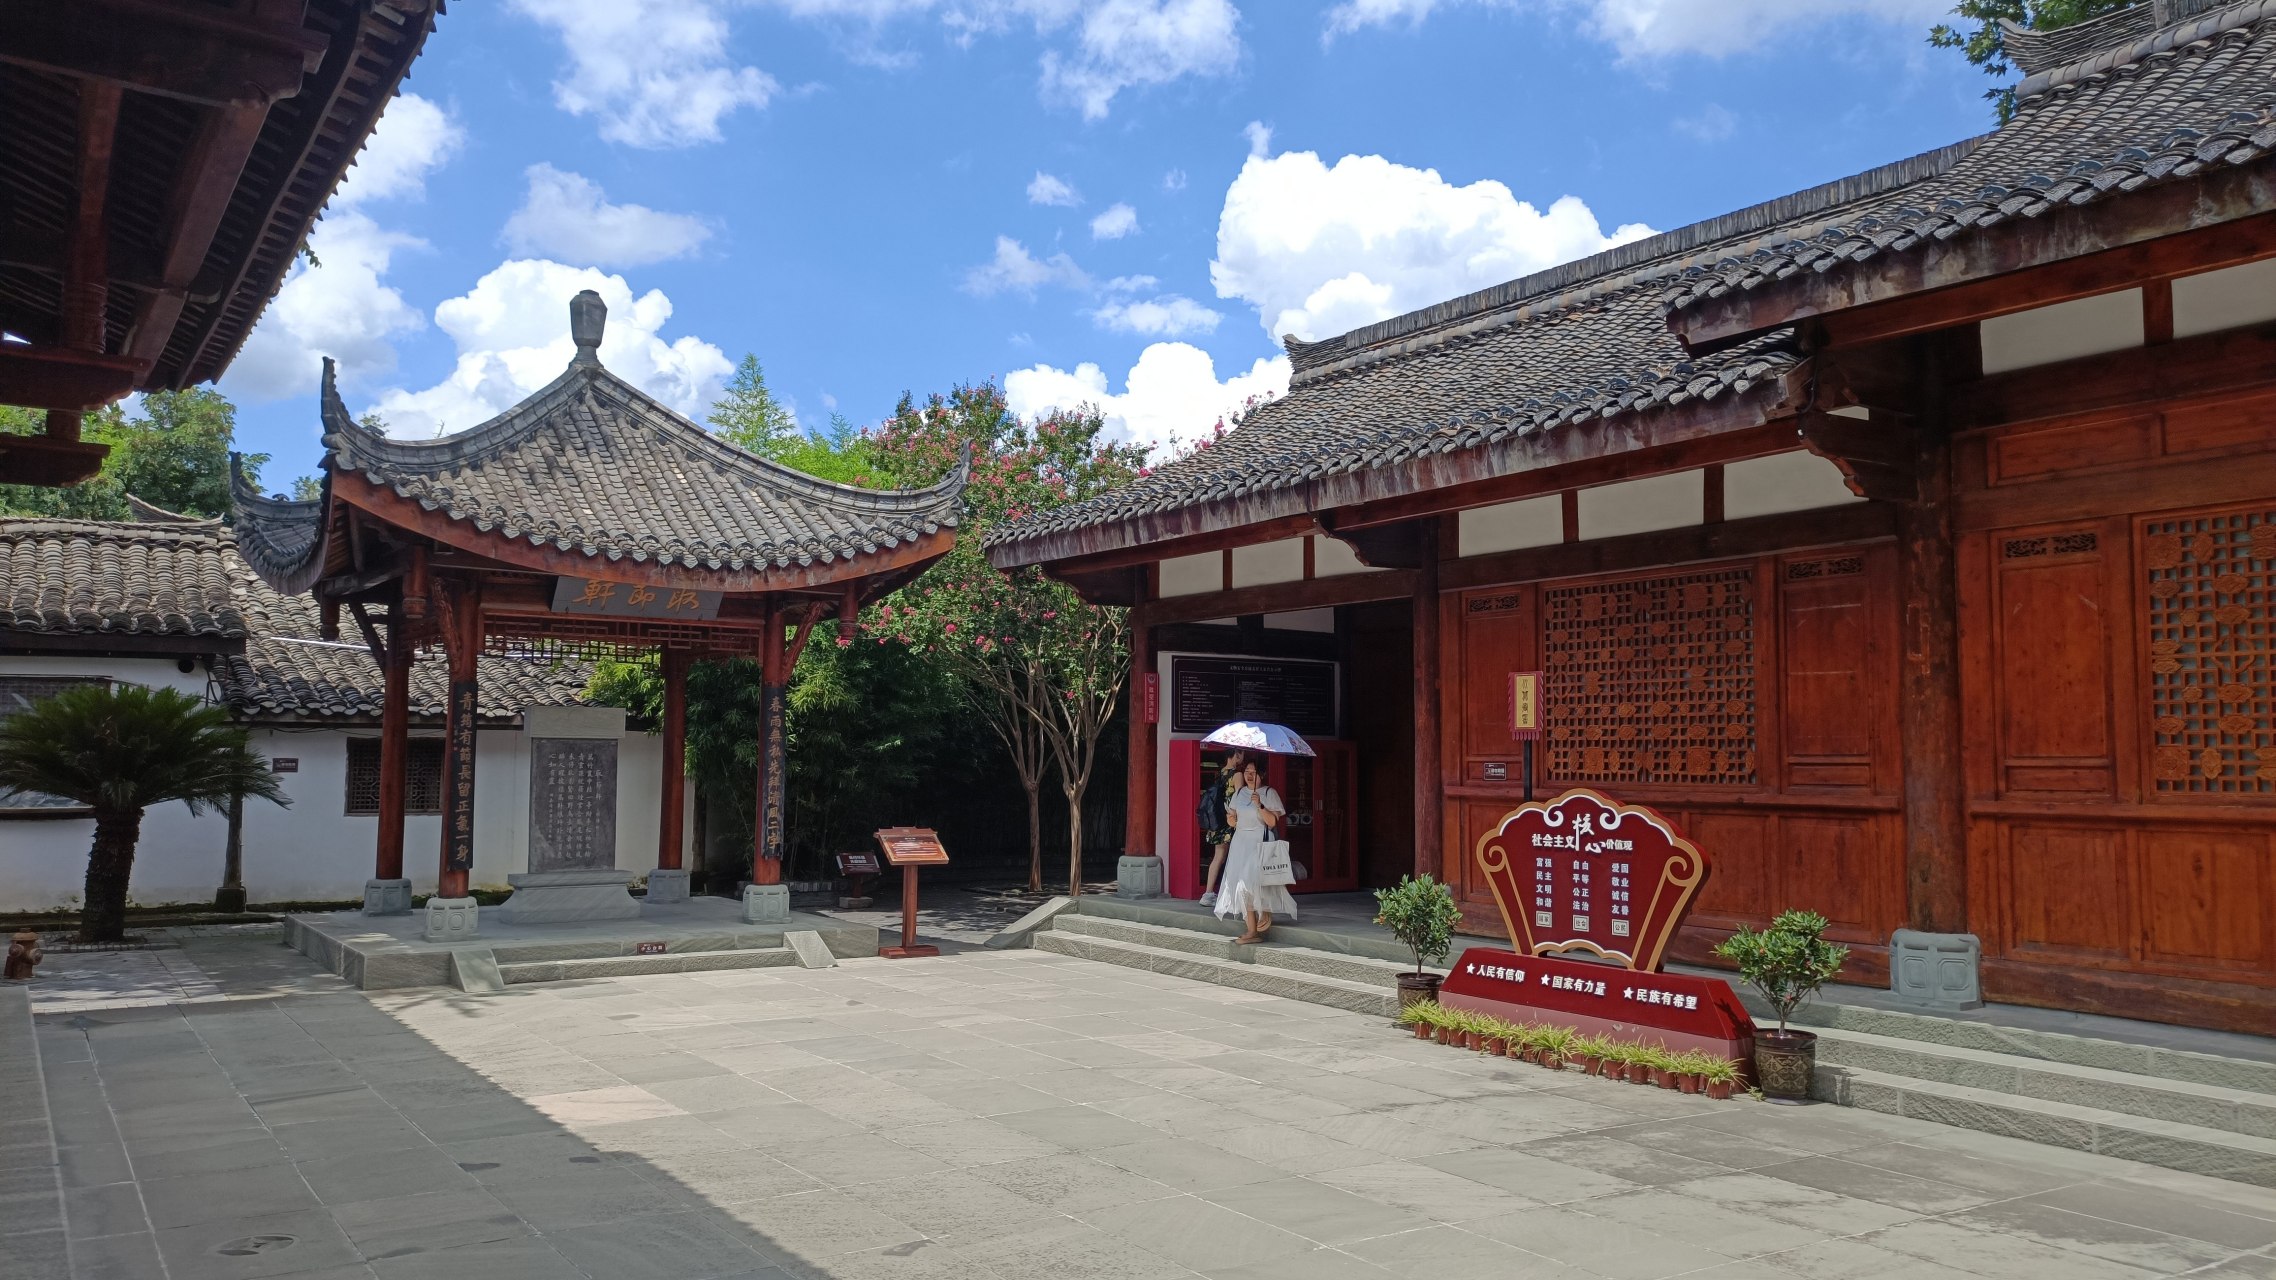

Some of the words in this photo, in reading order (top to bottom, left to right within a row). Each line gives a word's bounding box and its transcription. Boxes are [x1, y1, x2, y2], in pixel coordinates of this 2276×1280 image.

[1532, 833, 1575, 849] 社会主义
[1535, 857, 1553, 869] 富强
[1572, 860, 1590, 871] 自由
[1611, 863, 1630, 874] 爱国
[1535, 871, 1553, 882] 民主
[1572, 873, 1590, 885] 平等
[1611, 877, 1630, 888] 敬业
[1535, 884, 1553, 895] 文明
[1572, 887, 1590, 898] 公正
[1611, 890, 1630, 902] 诚信
[1535, 897, 1553, 909] 和谐
[1572, 900, 1590, 912] 法治
[1611, 904, 1630, 916] 友善
[1476, 964, 1526, 983] 人民有信仰
[1552, 975, 1607, 997] 国家有力量
[1636, 988, 1698, 1010] 民族有希望
